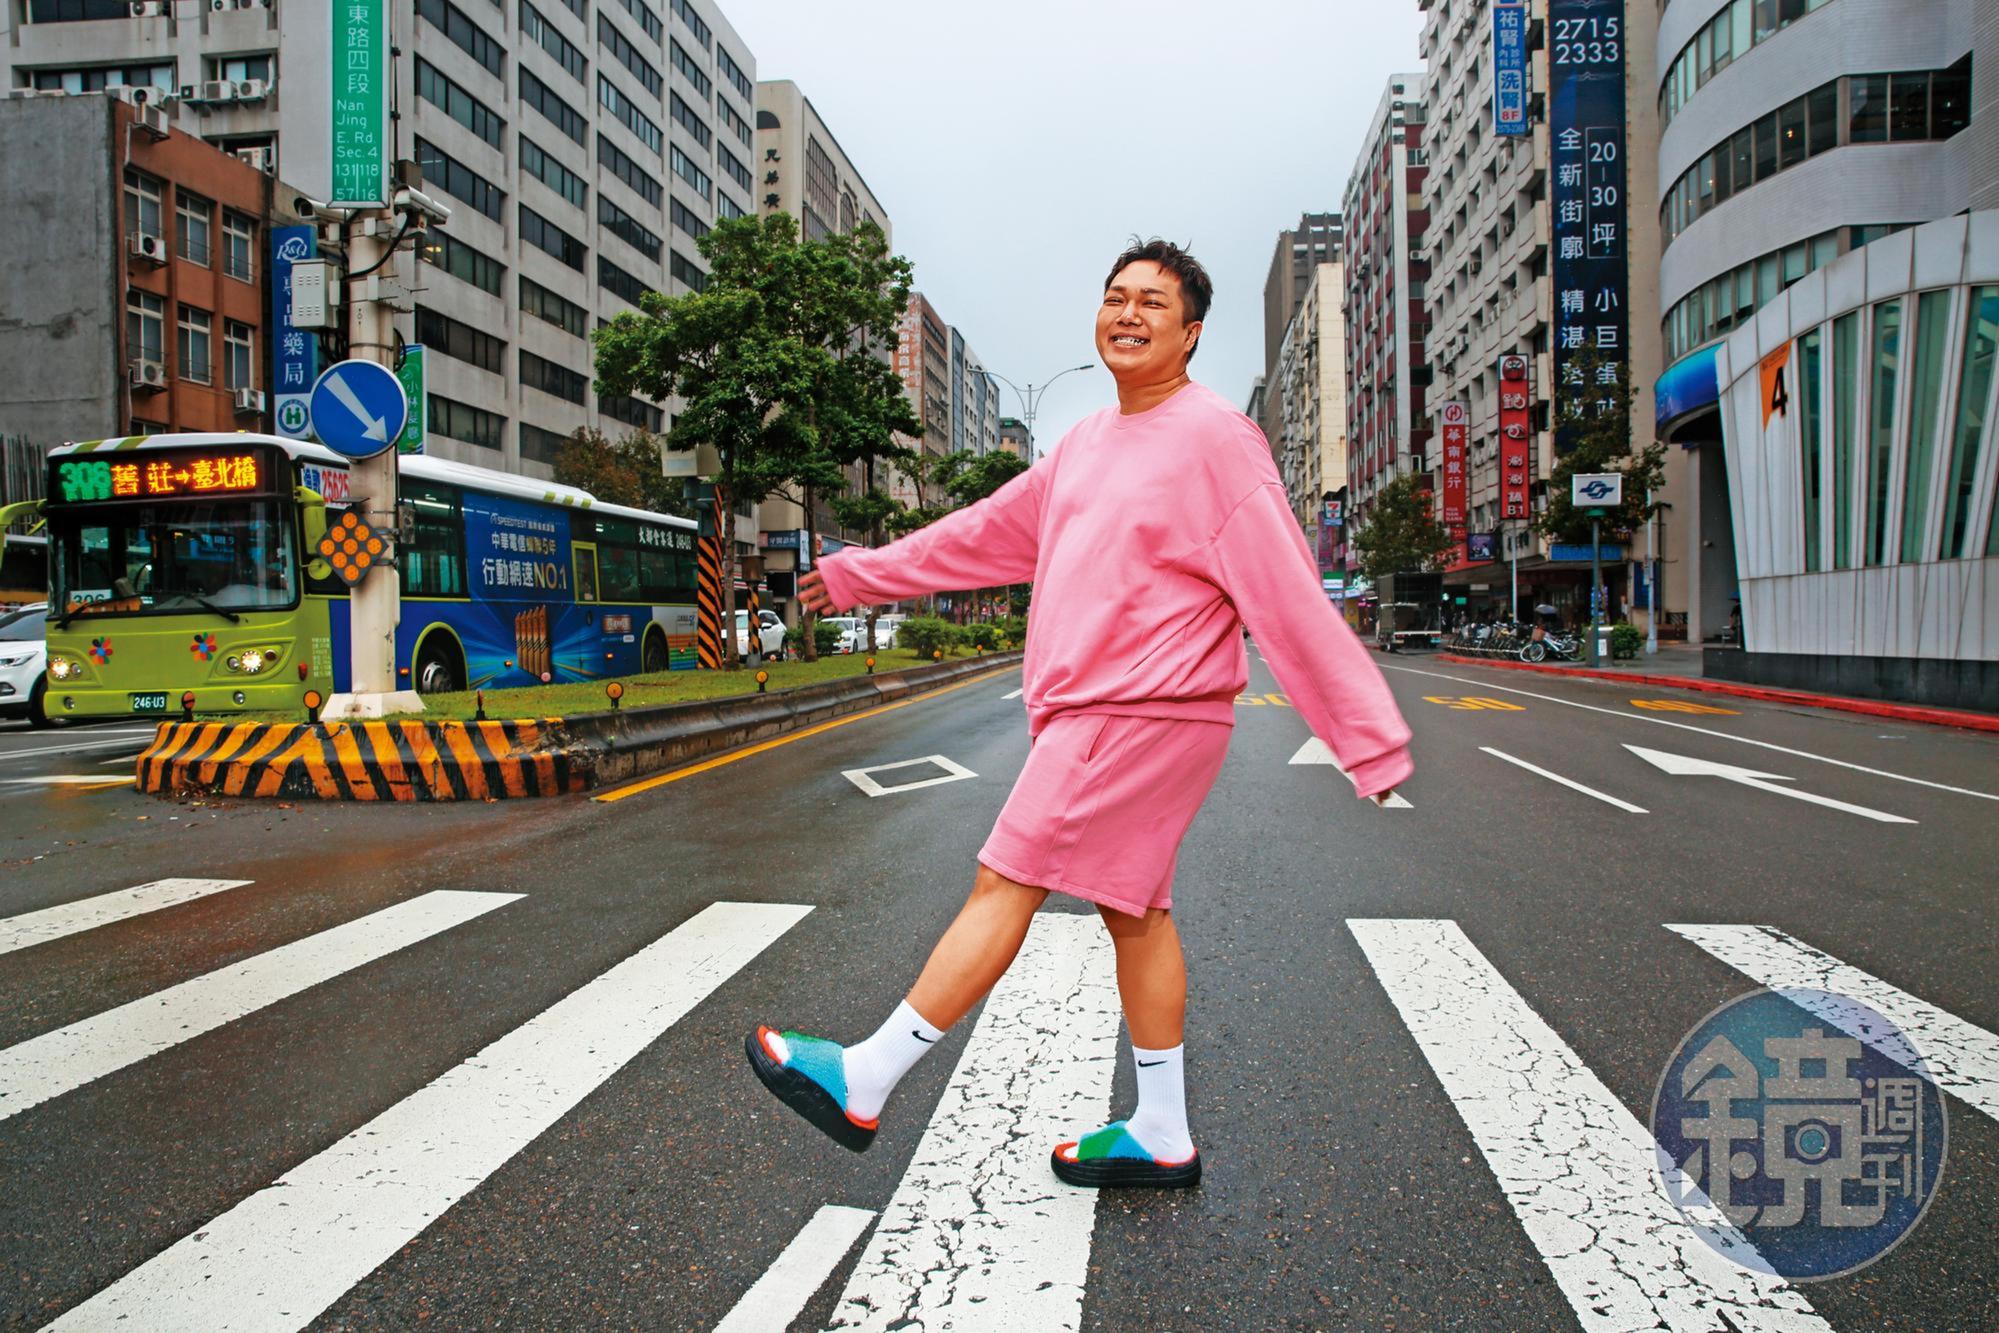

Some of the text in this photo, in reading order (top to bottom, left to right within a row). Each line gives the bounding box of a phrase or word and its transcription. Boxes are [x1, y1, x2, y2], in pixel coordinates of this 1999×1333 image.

[1555, 18, 1618, 39] 2715
[347, 0, 370, 94] 東路四段
[1555, 41, 1618, 65] 2333
[336, 99, 365, 111] Nan
[336, 113, 368, 129] Jing
[1502, 111, 1519, 120] 8F
[368, 147, 378, 158] 4
[336, 163, 379, 176] 131 118
[337, 188, 377, 200] 57 16
[1558, 128, 1584, 259] 全新街廓
[1771, 366, 1788, 417] 4
[1447, 428, 1461, 489] 華南銀行
[1507, 504, 1524, 515] B1
[482, 558, 567, 589] 行動網速NO.1
[134, 696, 165, 709] 246-U3
[1421, 696, 1527, 710] 50
